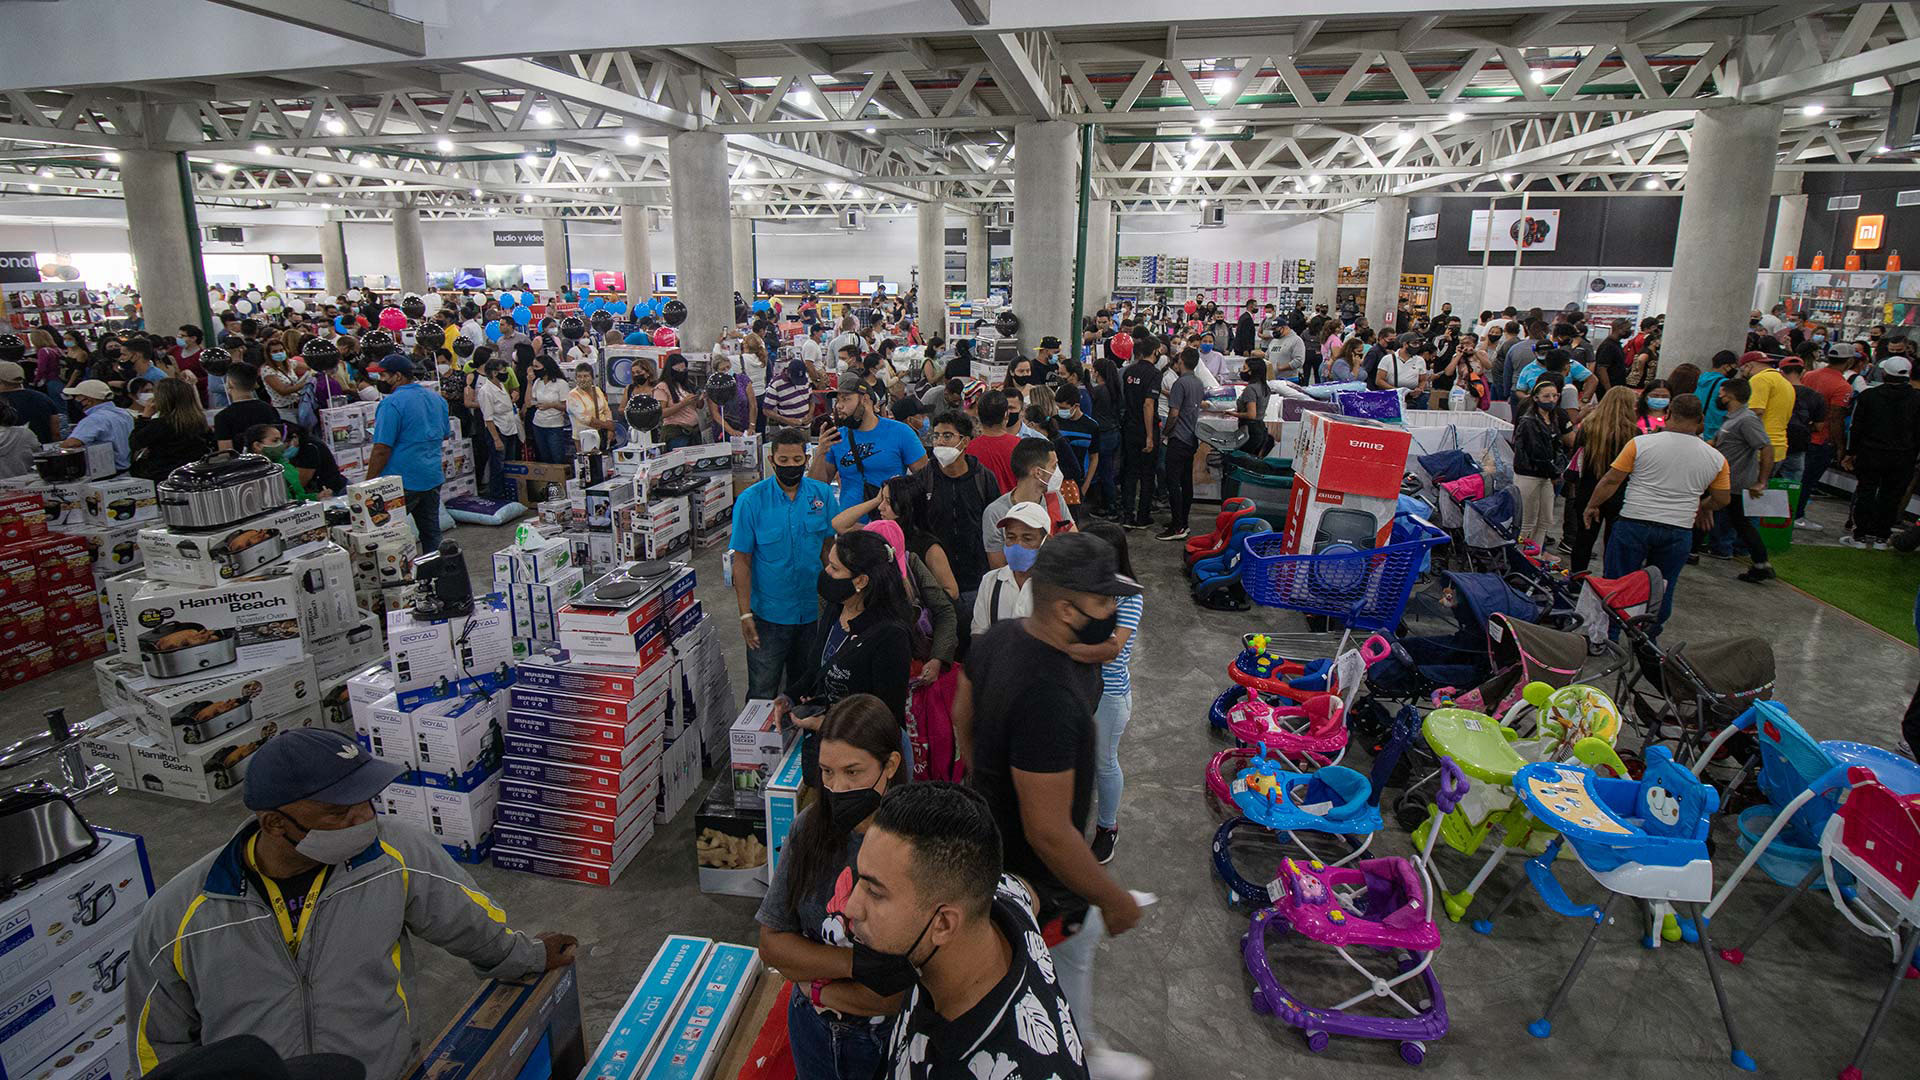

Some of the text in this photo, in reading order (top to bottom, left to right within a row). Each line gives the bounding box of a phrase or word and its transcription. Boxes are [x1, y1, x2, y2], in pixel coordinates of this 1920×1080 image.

[179, 590, 263, 610] Hamilton
[230, 597, 287, 613] Beach
[402, 632, 436, 642] ROYAL
[91, 749, 120, 761] Beach
[137, 749, 180, 763] Hamilton
[162, 760, 193, 773] Beach
[660, 944, 690, 985] SAMSUNG
